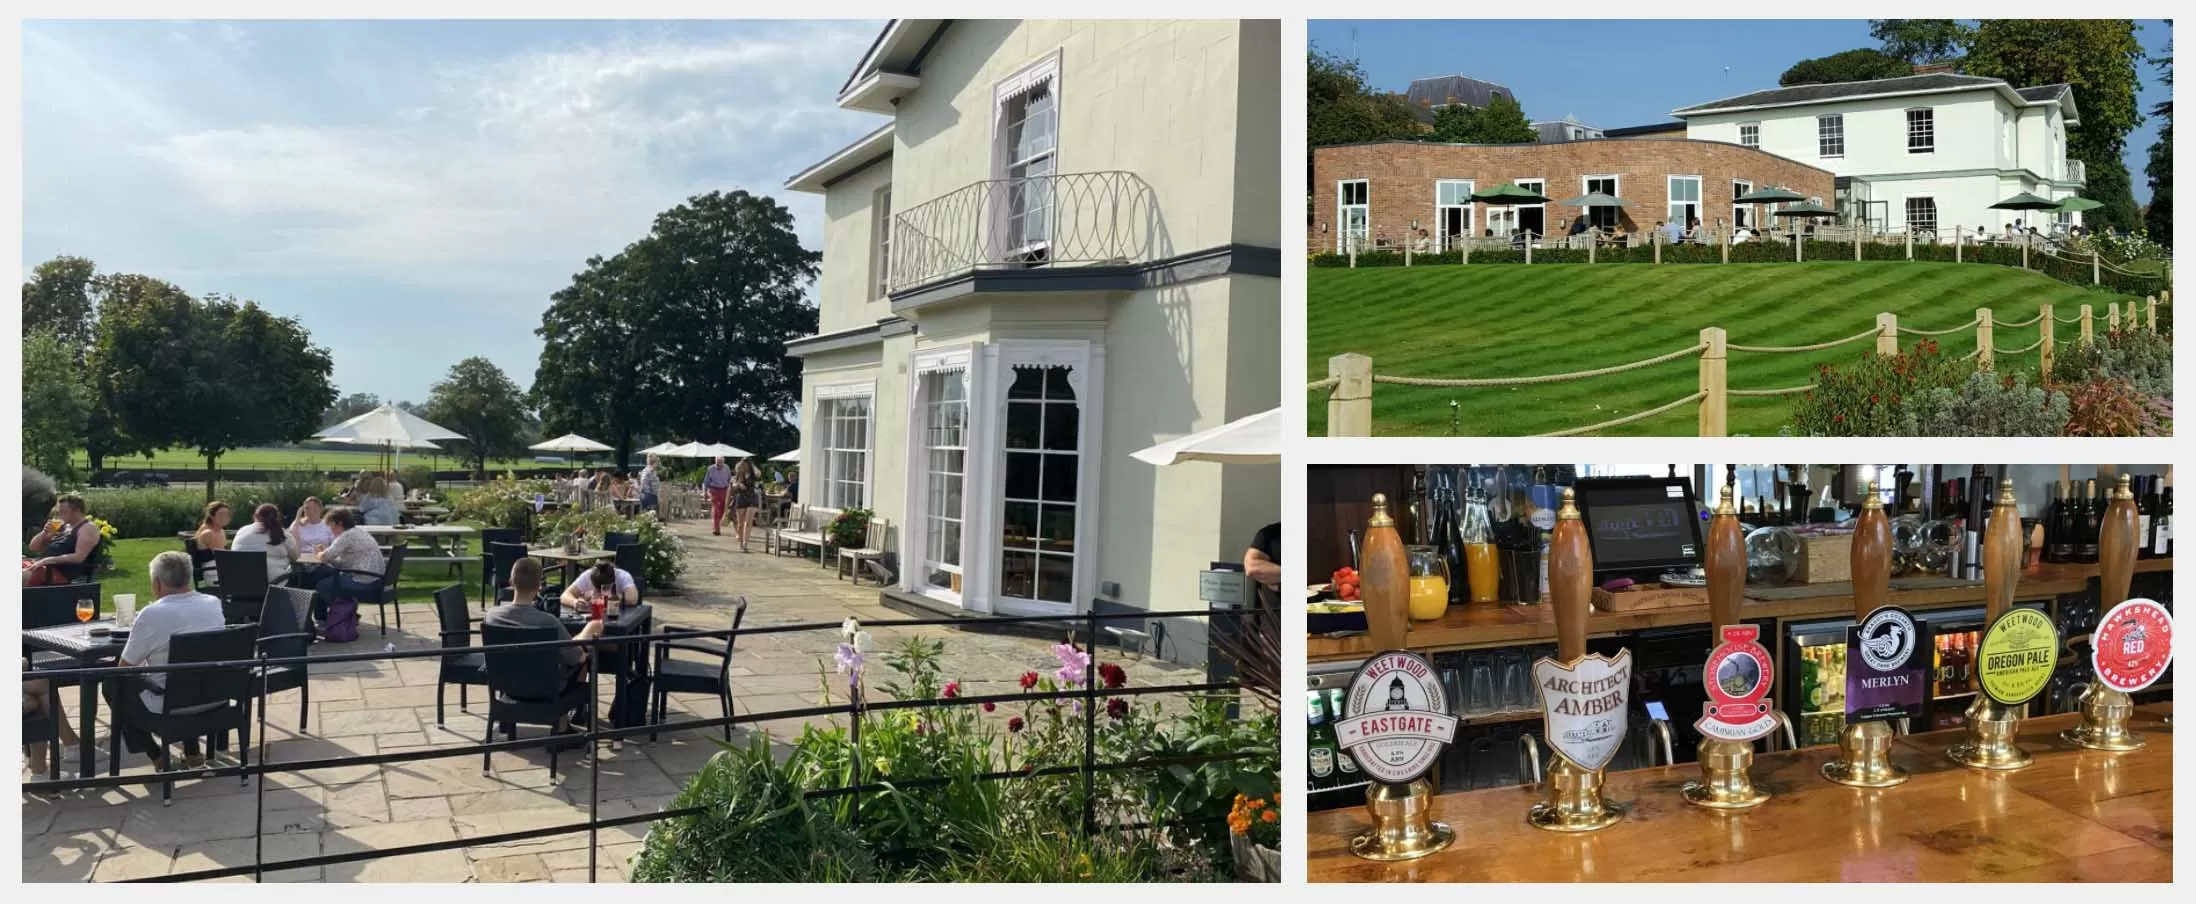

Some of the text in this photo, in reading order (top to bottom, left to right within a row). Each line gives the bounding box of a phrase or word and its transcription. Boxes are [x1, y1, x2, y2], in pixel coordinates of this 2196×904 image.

[1999, 614, 2043, 633] WEETWOOD
[2101, 606, 2169, 641] HAWKSHEAD
[2123, 640, 2145, 655] RED
[1366, 656, 1428, 680] WEETWOOD
[1987, 649, 2049, 670] OREGON PALE
[1544, 665, 1628, 695] ARCHITECT
[1861, 674, 1909, 690] MERLYN
[2103, 661, 2161, 685] BREWERY
[1553, 689, 1624, 716] AMBER
[1361, 716, 1433, 736] EASTGATE
[1748, 719, 1773, 735] GOLD
